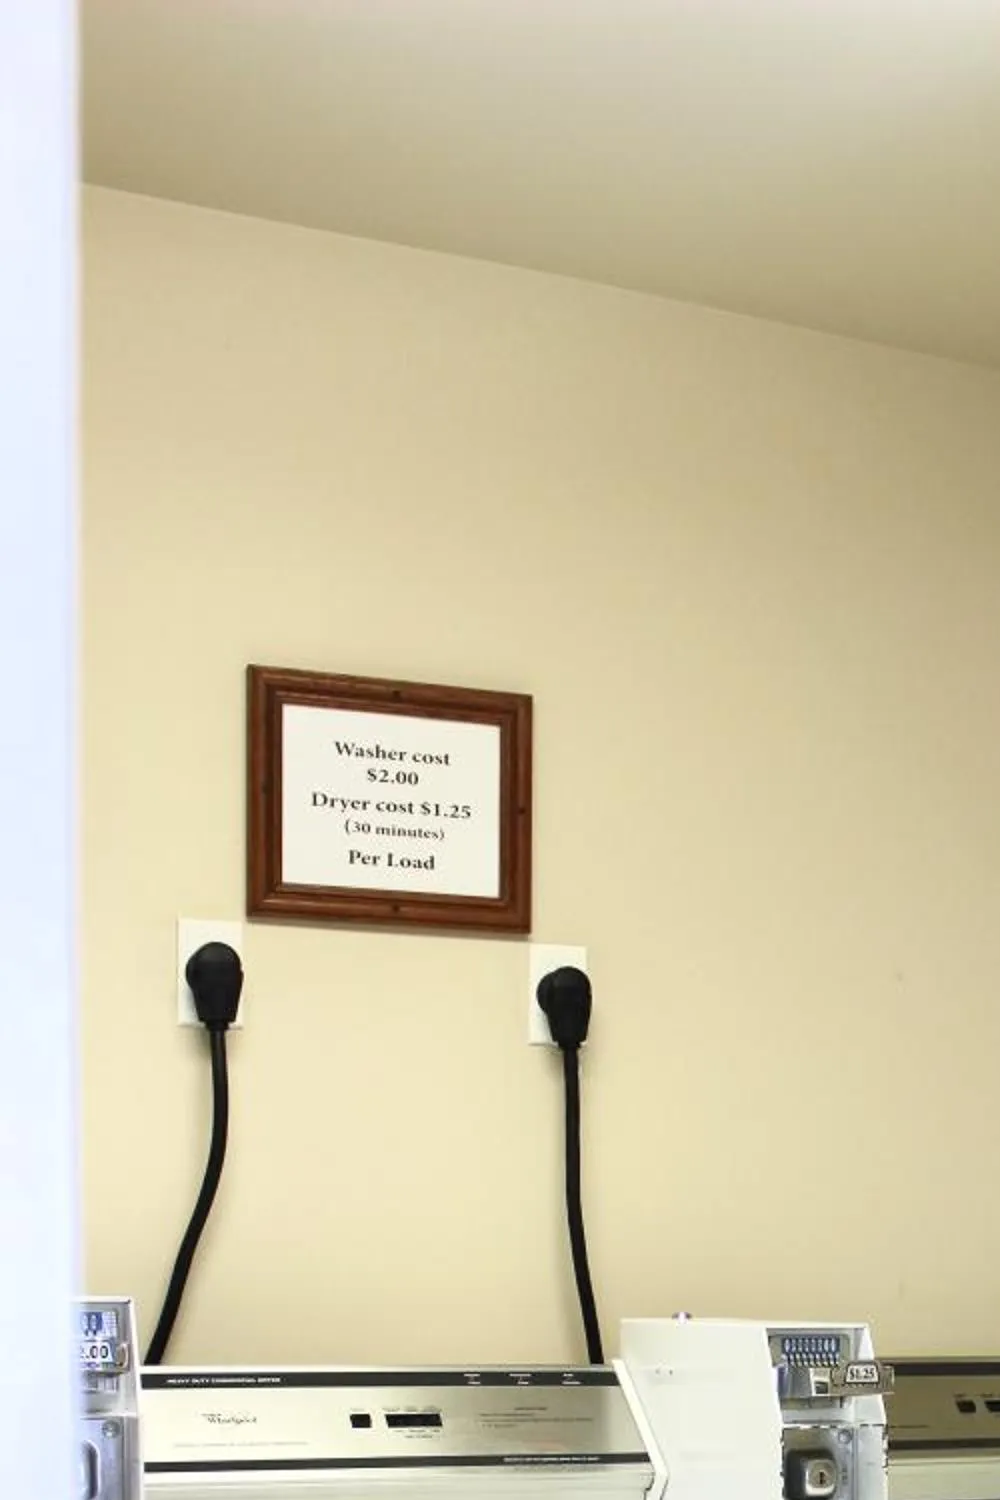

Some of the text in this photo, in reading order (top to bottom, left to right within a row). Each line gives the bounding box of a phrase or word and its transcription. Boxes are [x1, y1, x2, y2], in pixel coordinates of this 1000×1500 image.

[334, 741, 451, 766] Washer cost
[366, 768, 420, 786] $2.00
[311, 791, 472, 819] Dryer cost $1.25
[344, 819, 445, 841] (30 minutes)
[348, 849, 436, 871] Per Load
